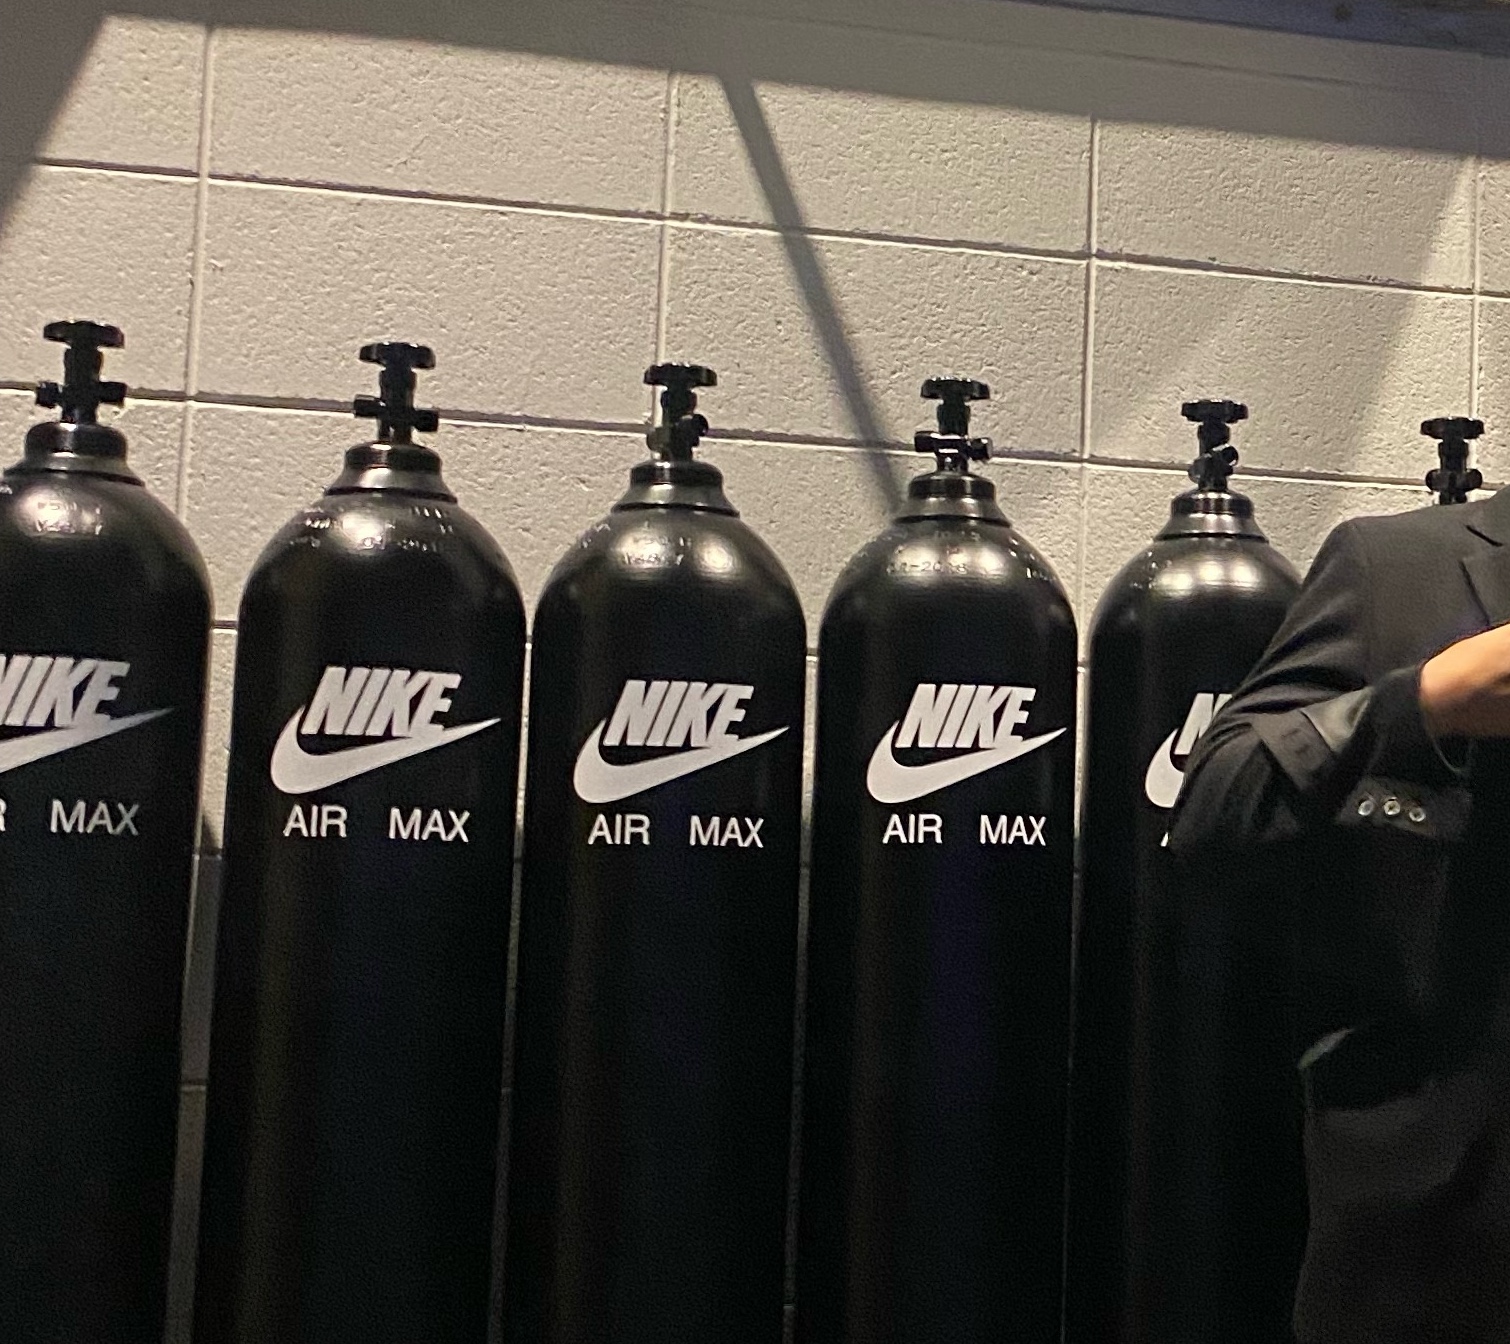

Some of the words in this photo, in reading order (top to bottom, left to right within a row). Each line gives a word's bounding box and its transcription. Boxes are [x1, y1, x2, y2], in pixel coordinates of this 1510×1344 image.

[301, 666, 462, 736] NIKE
[603, 680, 754, 747] NIKE
[895, 683, 1036, 749] NIKE
[50, 798, 139, 836] MAX
[283, 804, 347, 838] AIR
[388, 807, 470, 843] MAX
[588, 814, 650, 846] AIR
[689, 816, 764, 849] MAX
[882, 813, 943, 844] AIR
[979, 814, 1047, 847] MAX
